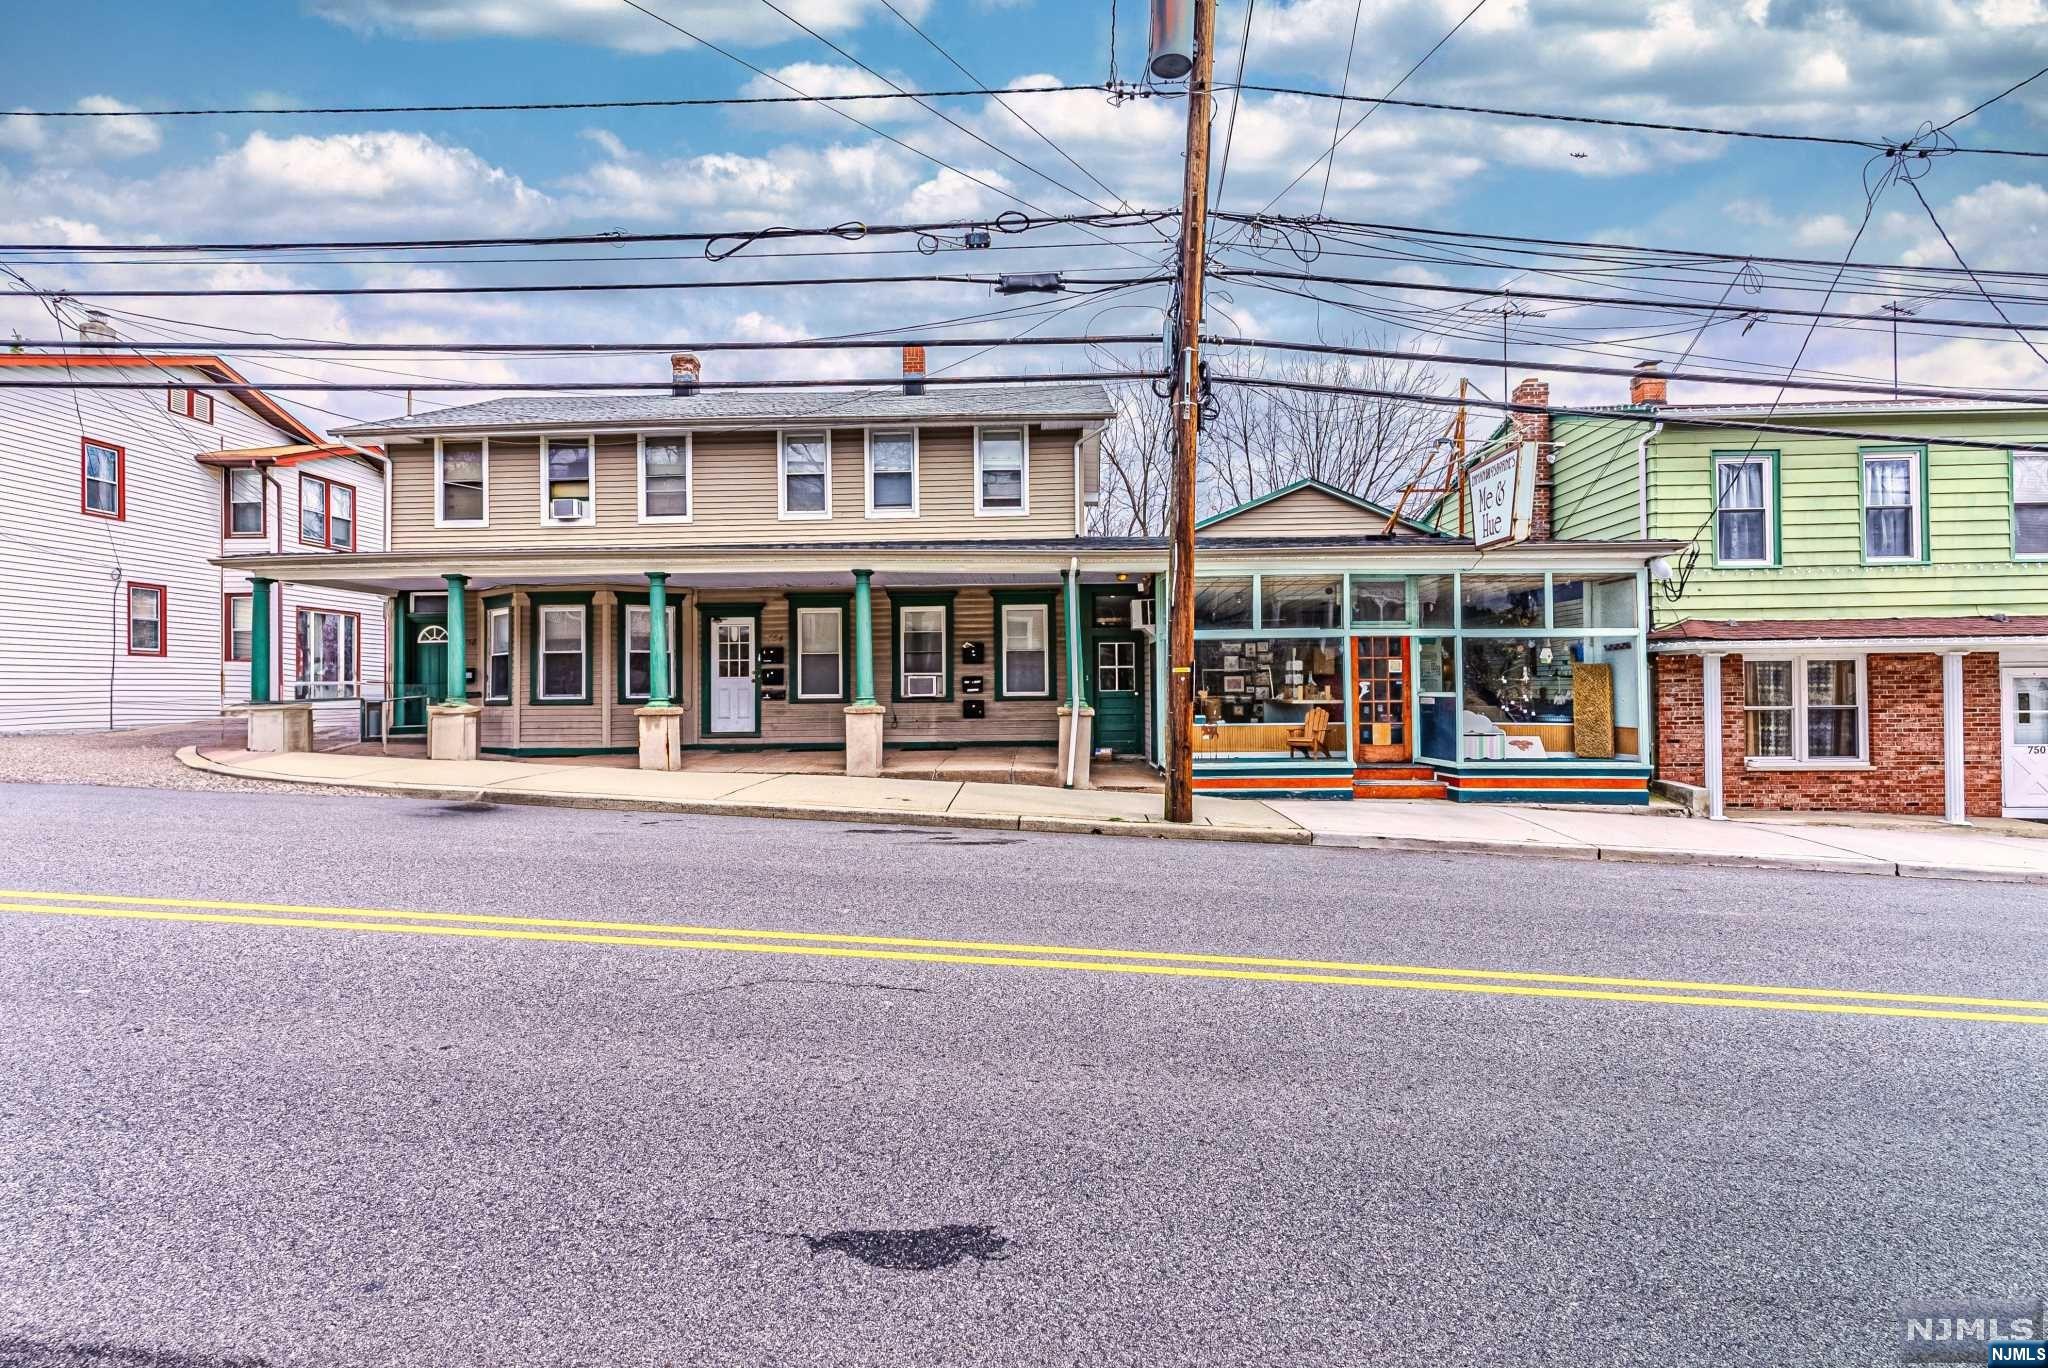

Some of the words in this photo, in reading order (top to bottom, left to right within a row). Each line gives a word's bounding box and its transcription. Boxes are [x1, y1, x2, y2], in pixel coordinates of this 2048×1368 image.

[1479, 487, 1493, 512] Me
[1496, 480, 1506, 506] &
[1482, 513, 1502, 538] Hue
[2027, 745, 2046, 754] 750
